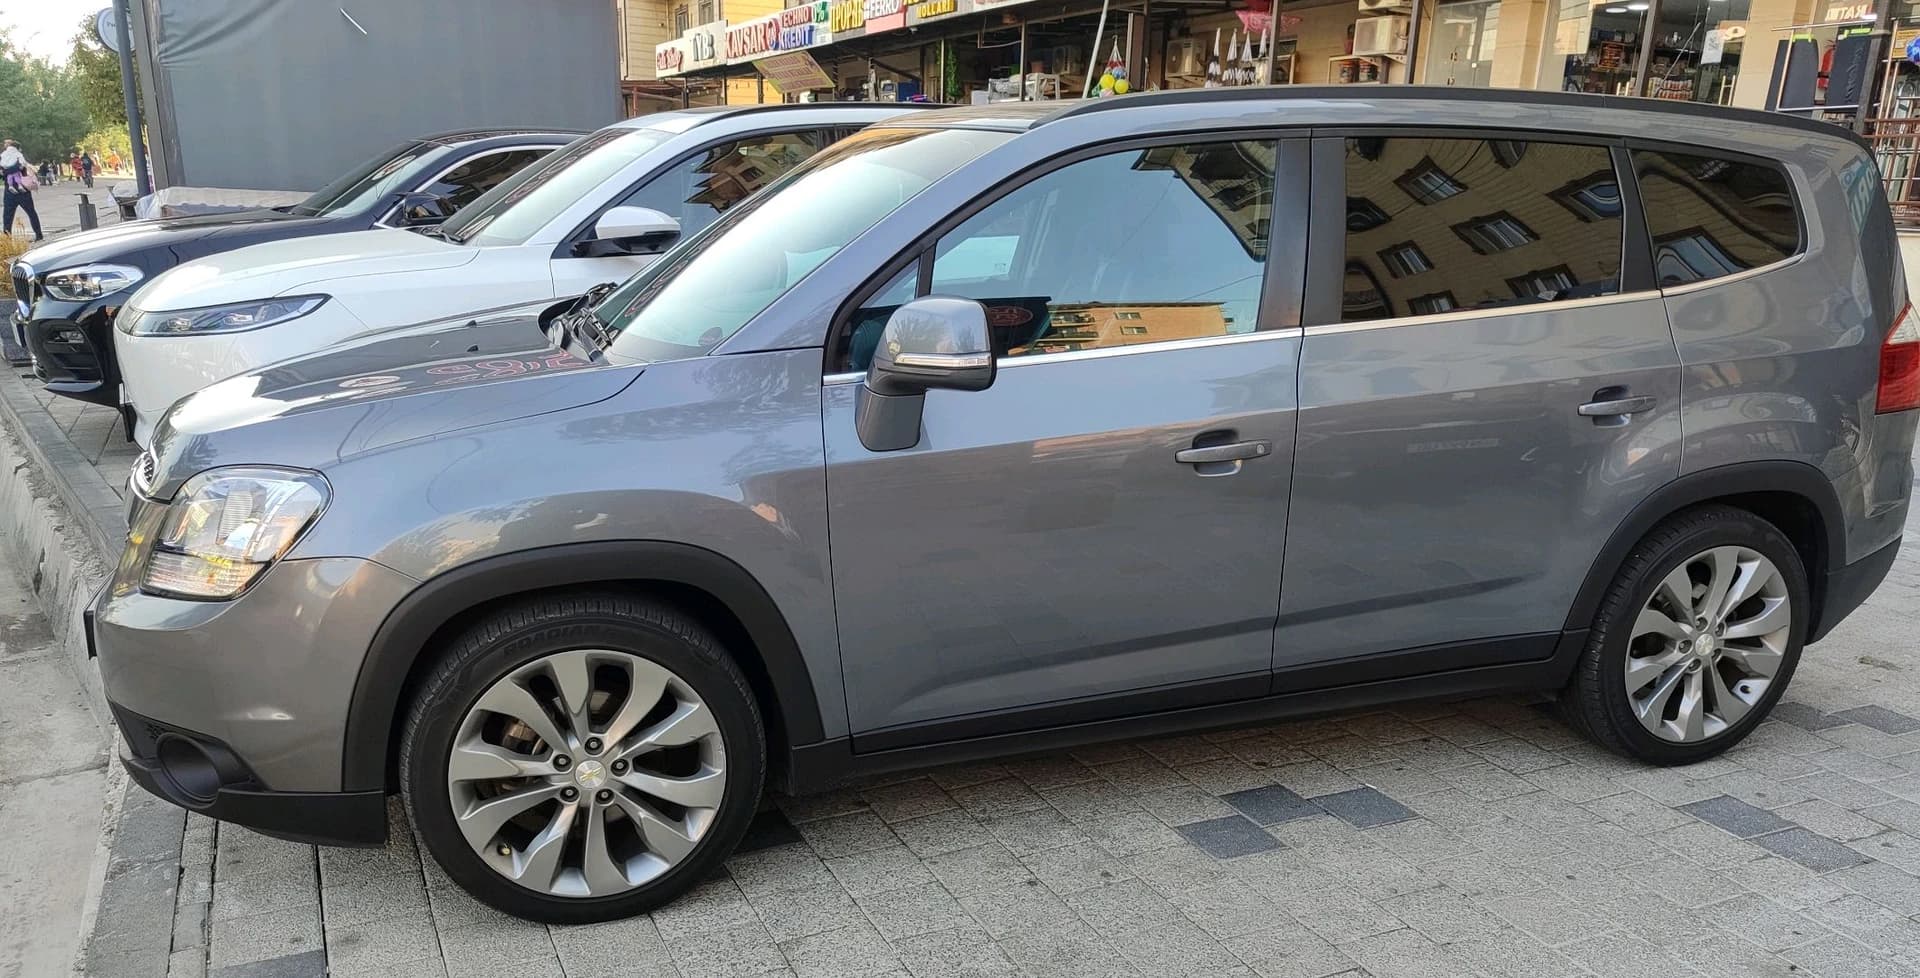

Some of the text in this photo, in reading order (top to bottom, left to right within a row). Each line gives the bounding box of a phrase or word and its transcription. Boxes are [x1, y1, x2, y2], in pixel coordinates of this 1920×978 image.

[779, 7, 811, 28] TECHNO
[725, 23, 767, 58] KAVSAR
[779, 25, 814, 50] KREDIT
